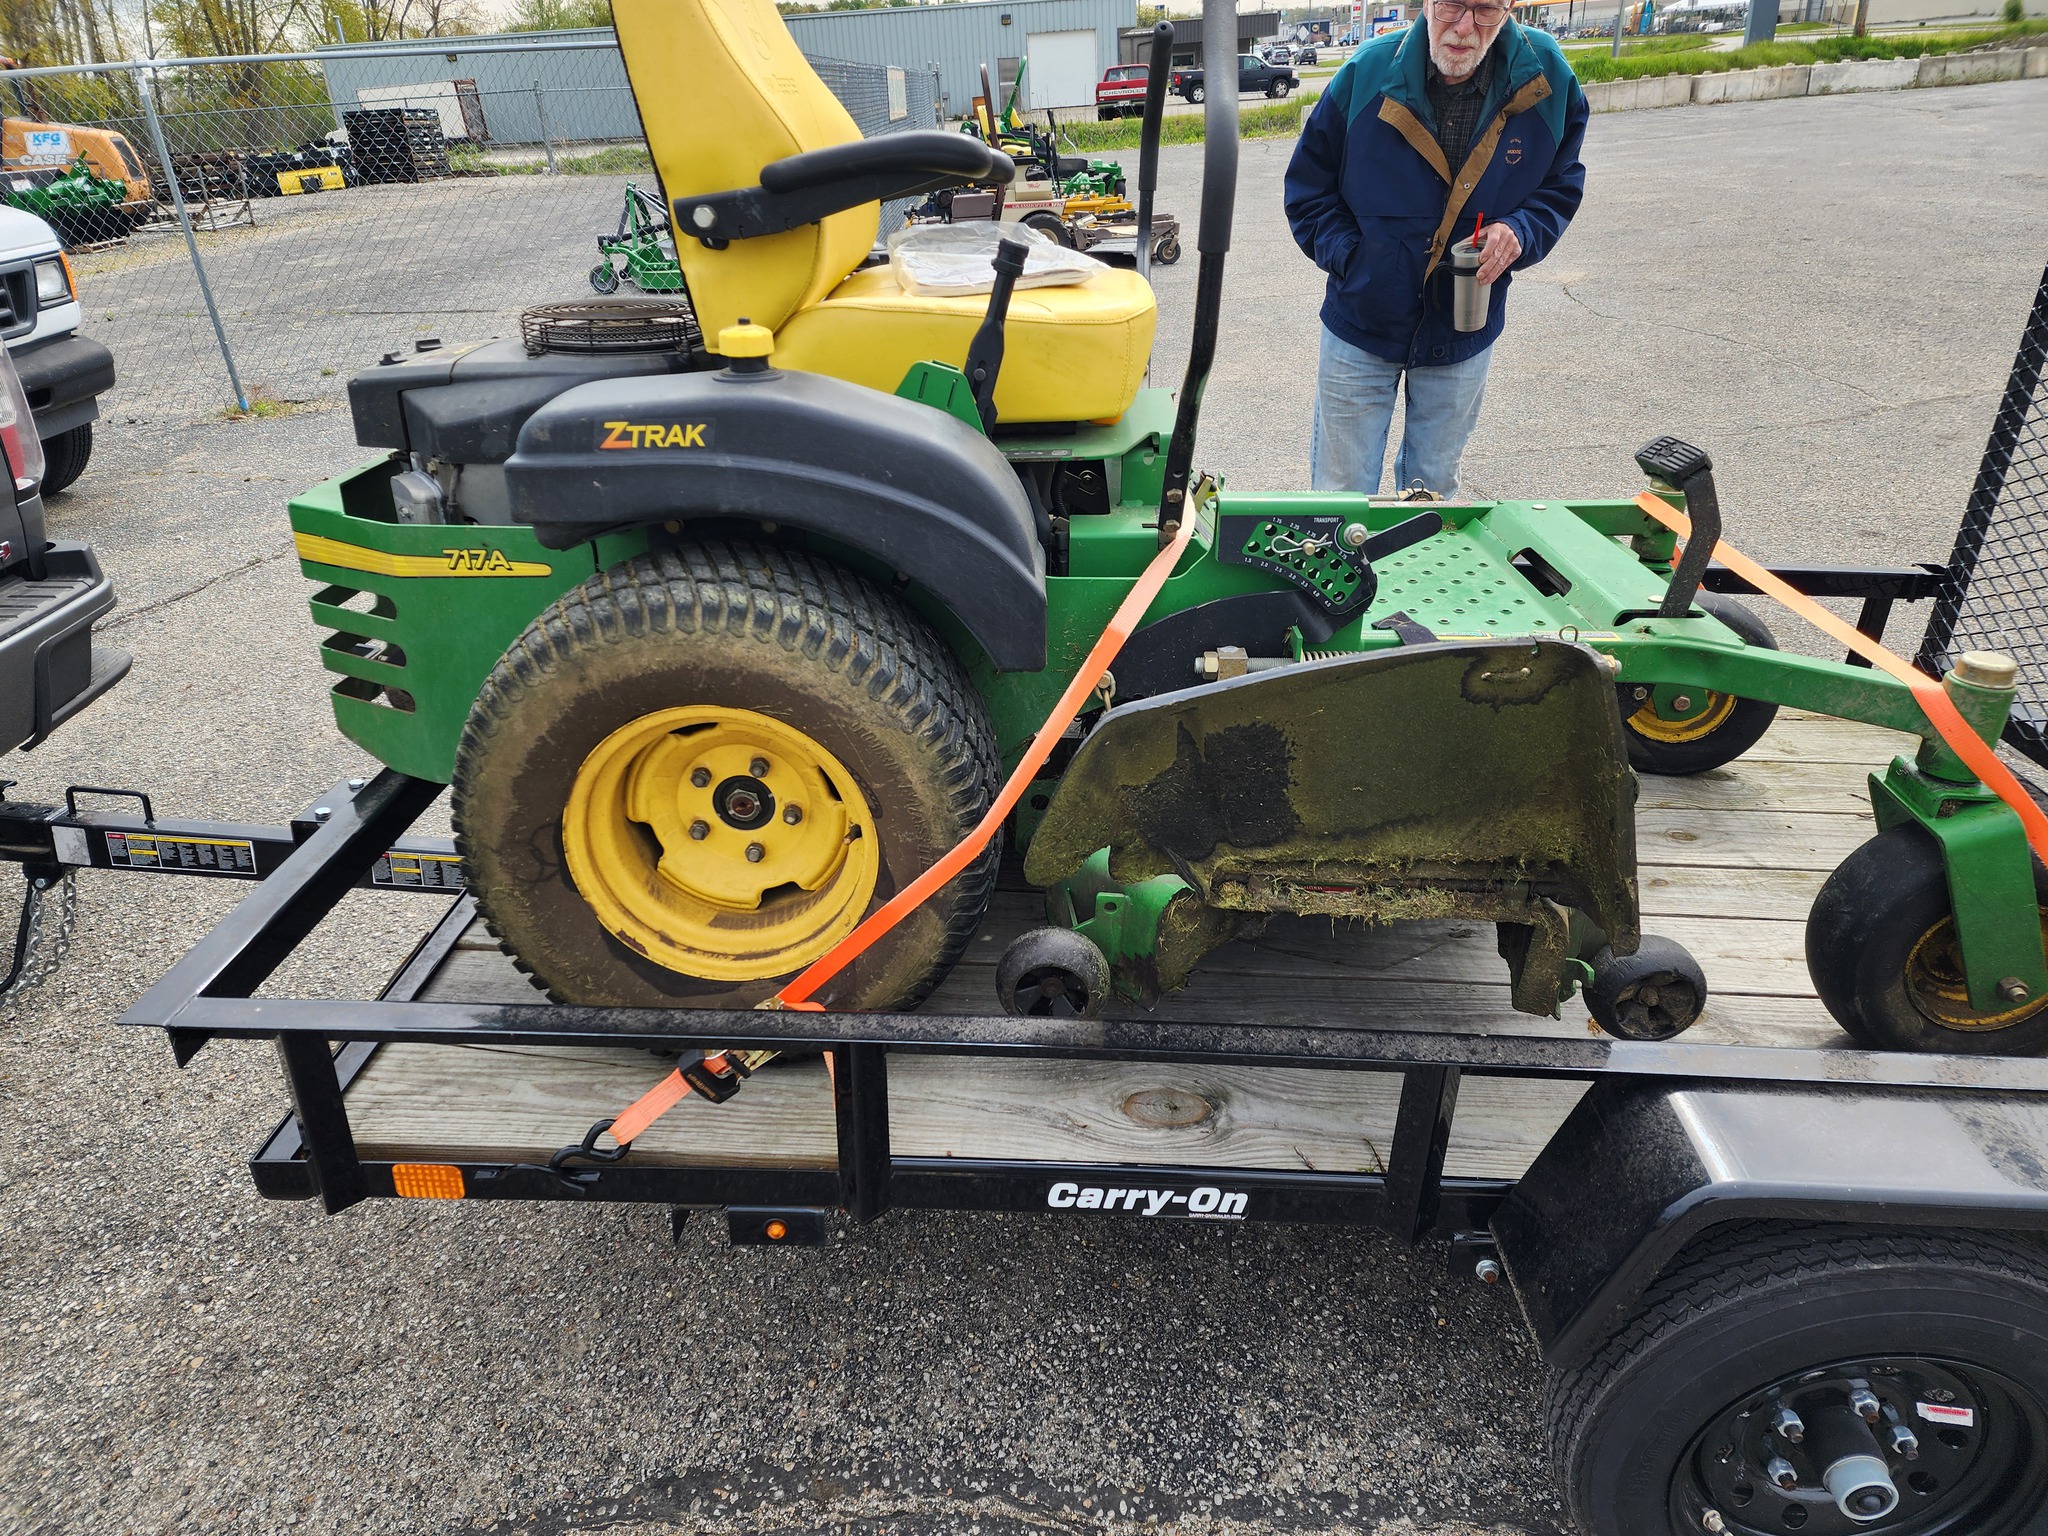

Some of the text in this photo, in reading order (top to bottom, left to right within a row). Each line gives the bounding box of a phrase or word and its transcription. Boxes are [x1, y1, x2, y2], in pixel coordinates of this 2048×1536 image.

[1103, 88, 1146, 96] CHEVROLET
[19, 154, 67, 166] CASE
[599, 421, 707, 450] ZTRAK
[1289, 522, 1300, 531] 2.25
[442, 549, 513, 571] 717A
[1274, 566, 1283, 574] 2.5
[1047, 1182, 1249, 1216] Carry-On
